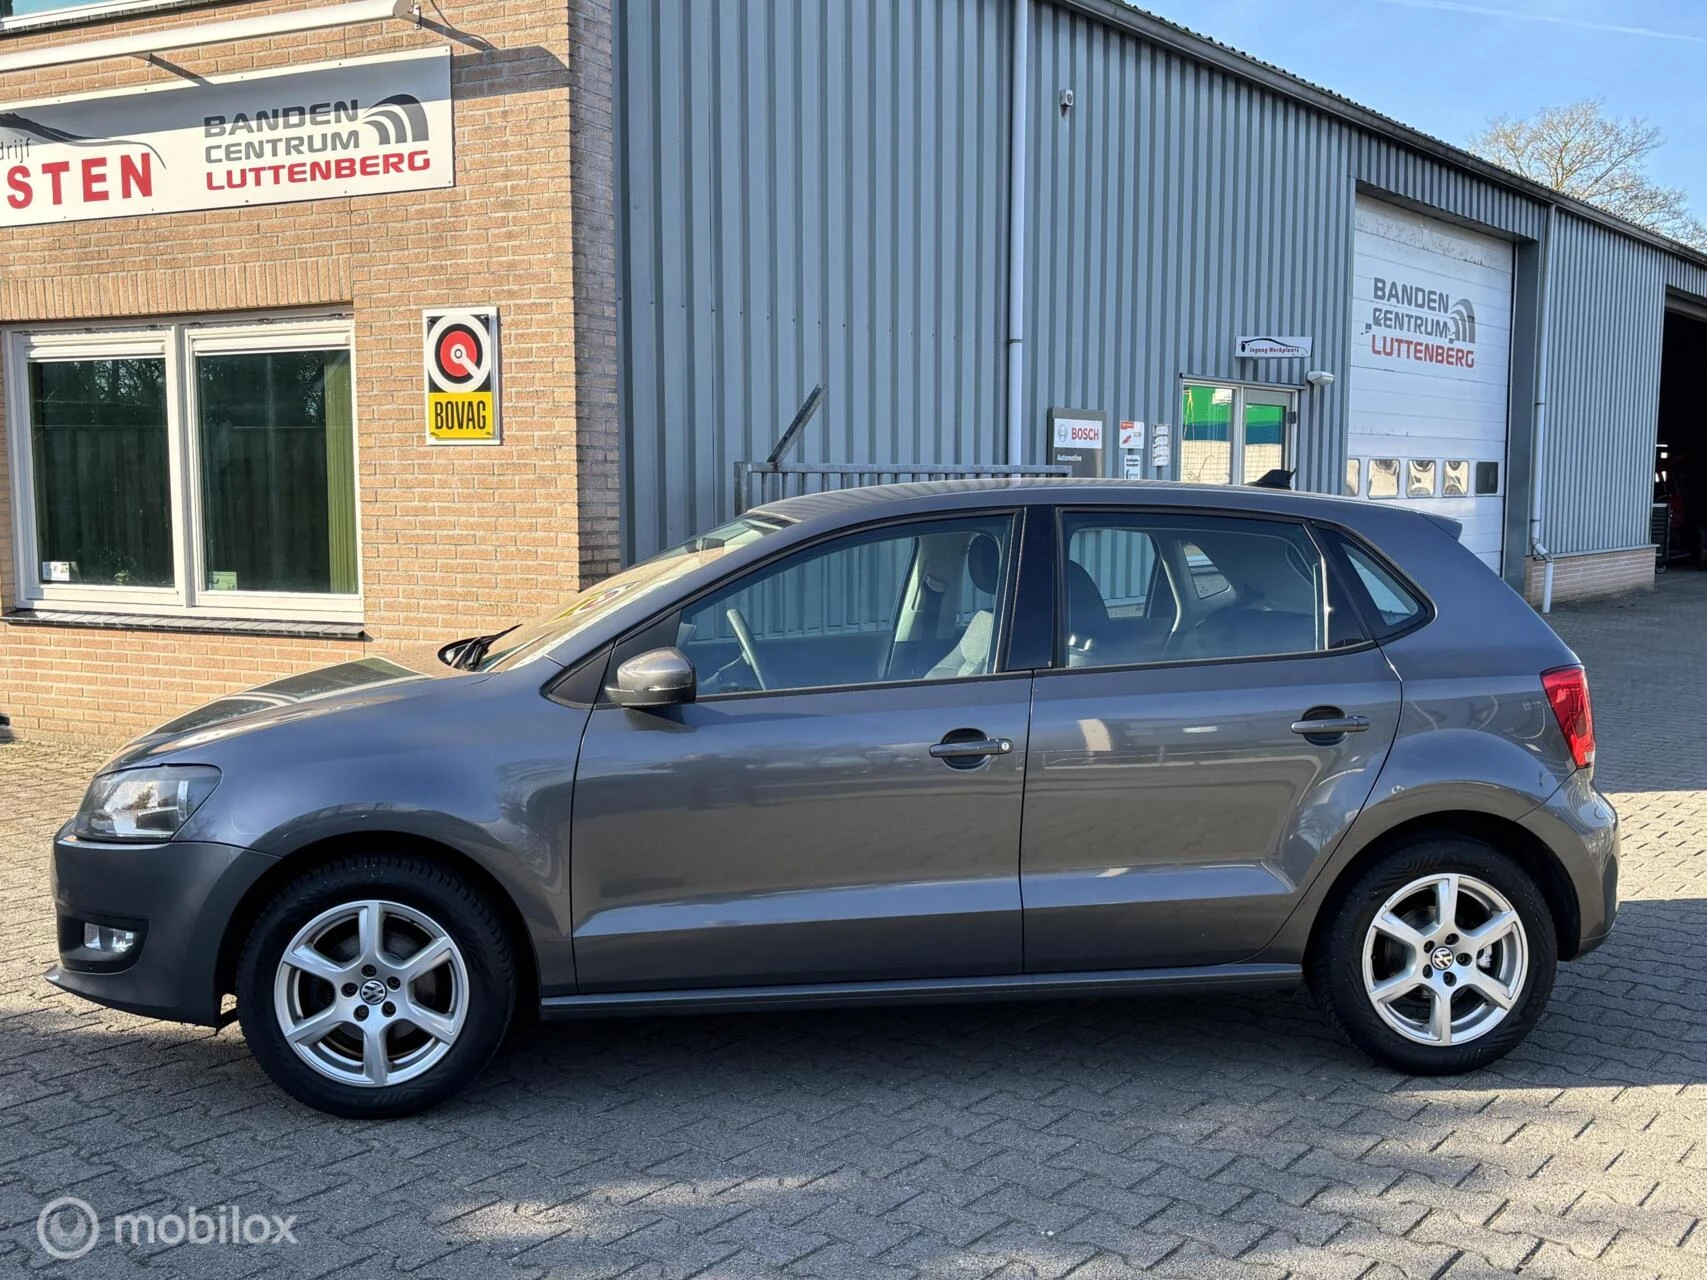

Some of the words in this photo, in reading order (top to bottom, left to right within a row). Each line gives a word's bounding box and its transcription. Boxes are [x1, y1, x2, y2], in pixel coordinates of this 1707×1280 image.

[203, 99, 359, 138] BANDEN
[204, 130, 360, 164] CENTRUM
[7, 152, 154, 209] STEN
[206, 150, 431, 191] LUTTENBERG
[1373, 277, 1450, 314] BANDEN
[1372, 307, 1449, 339] CENTRUM
[1371, 334, 1475, 369] LUTTENBERG
[434, 400, 487, 430] BOVAG
[1071, 427, 1100, 441] BOSCH
[1056, 454, 1082, 462] Automotive
